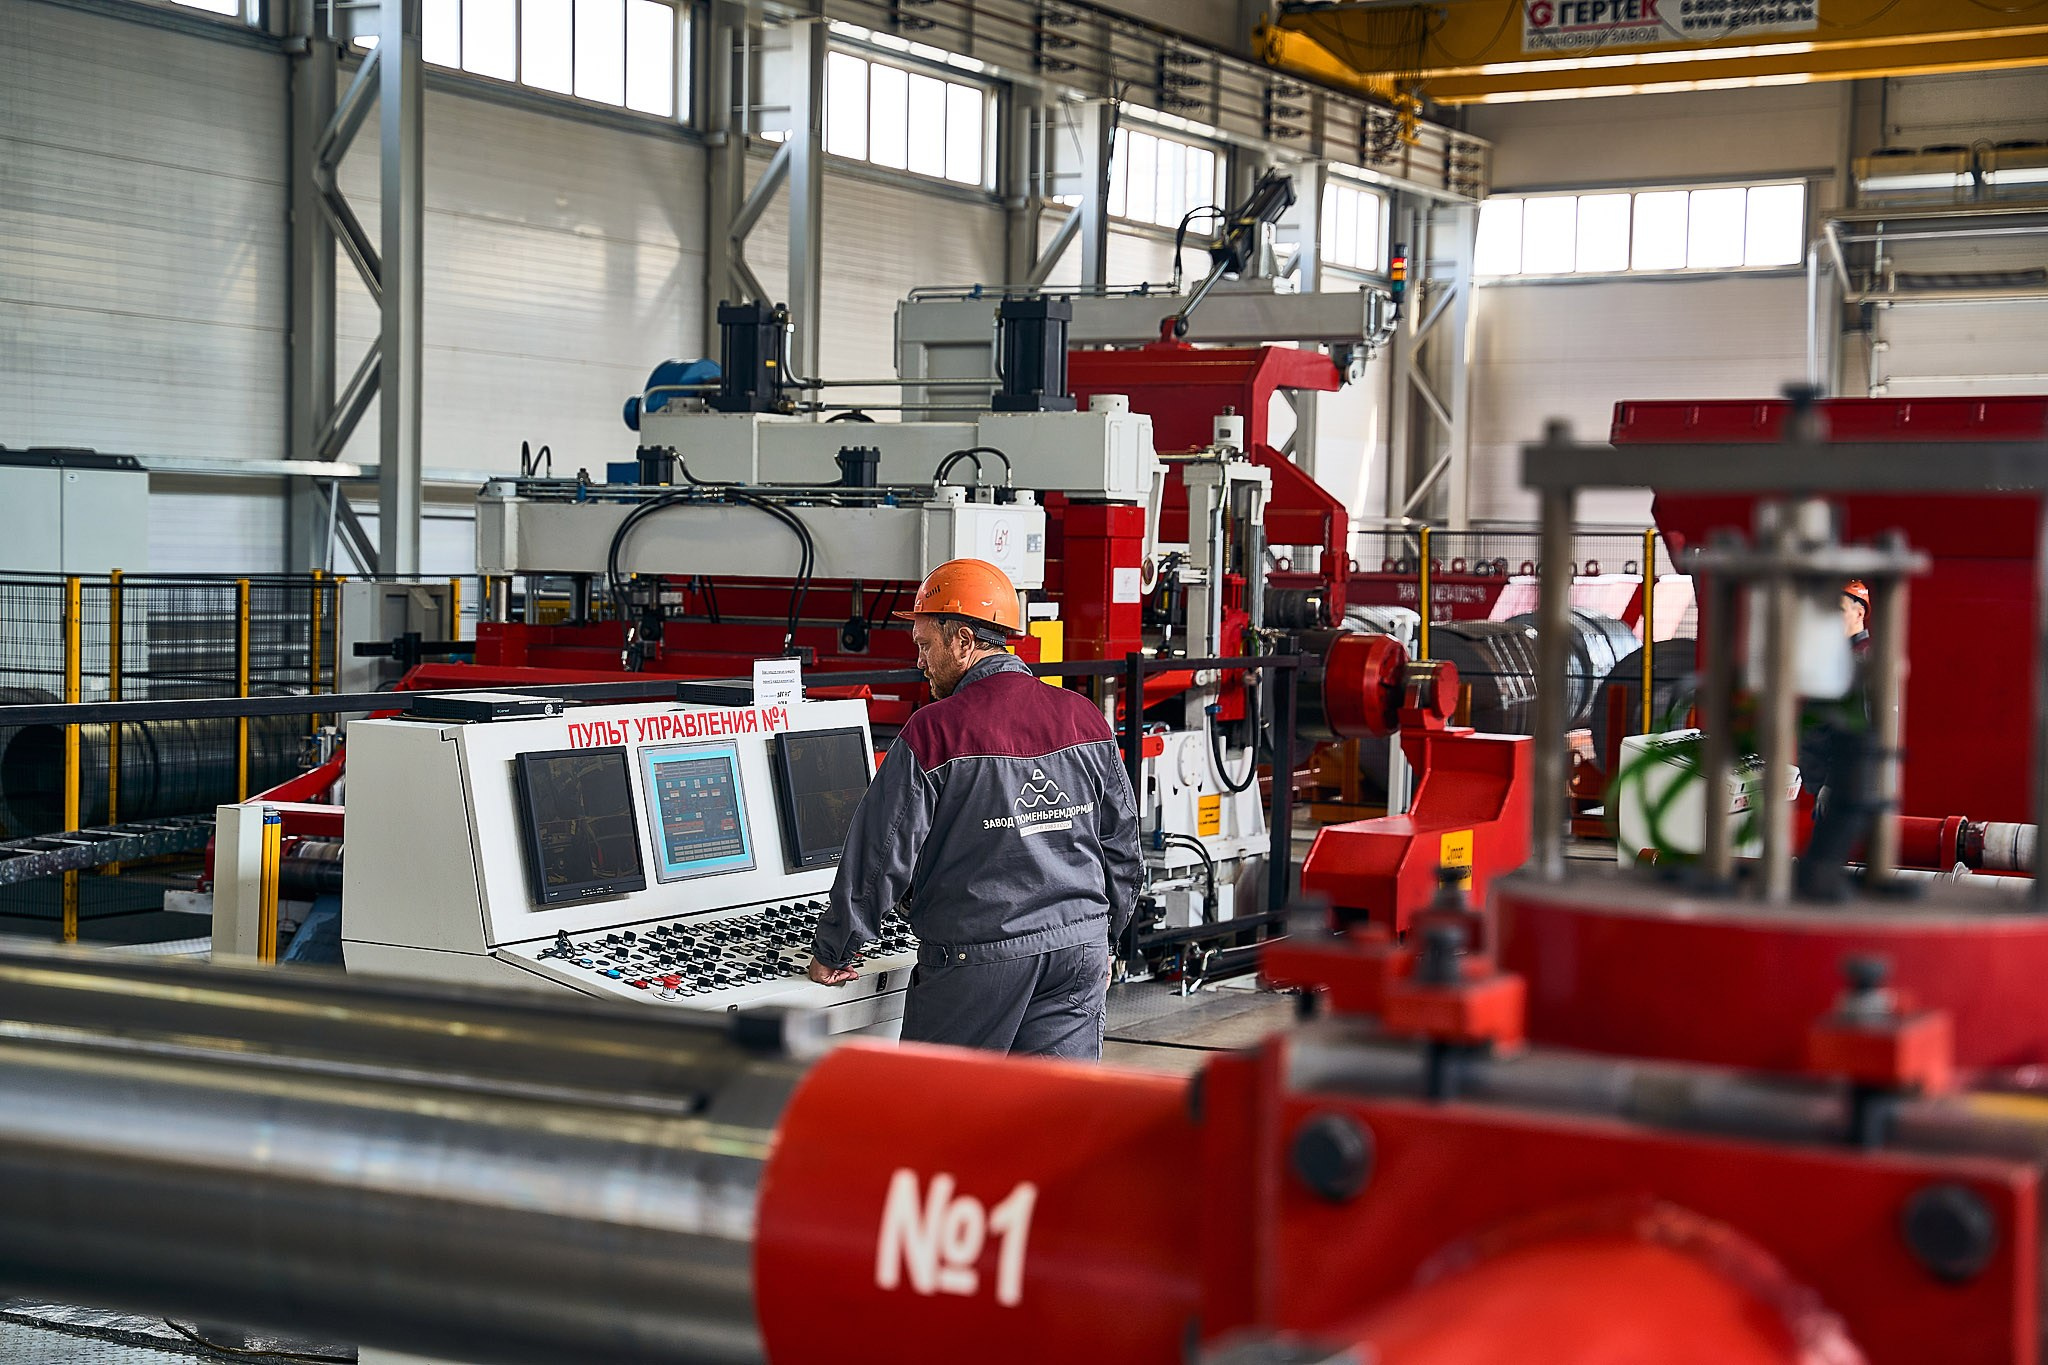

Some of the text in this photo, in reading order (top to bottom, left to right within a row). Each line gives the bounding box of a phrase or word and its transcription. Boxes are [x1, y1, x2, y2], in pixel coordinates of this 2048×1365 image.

[1558, 0, 1659, 25] ГЕРТЕК
[1681, 7, 1814, 31] www.gertek.ru
[568, 705, 789, 748] ПУЛЬТ УПРАВЛЕНИЯ №1
[983, 817, 1014, 829] ЗАВОД
[874, 1166, 1038, 1308] №1
